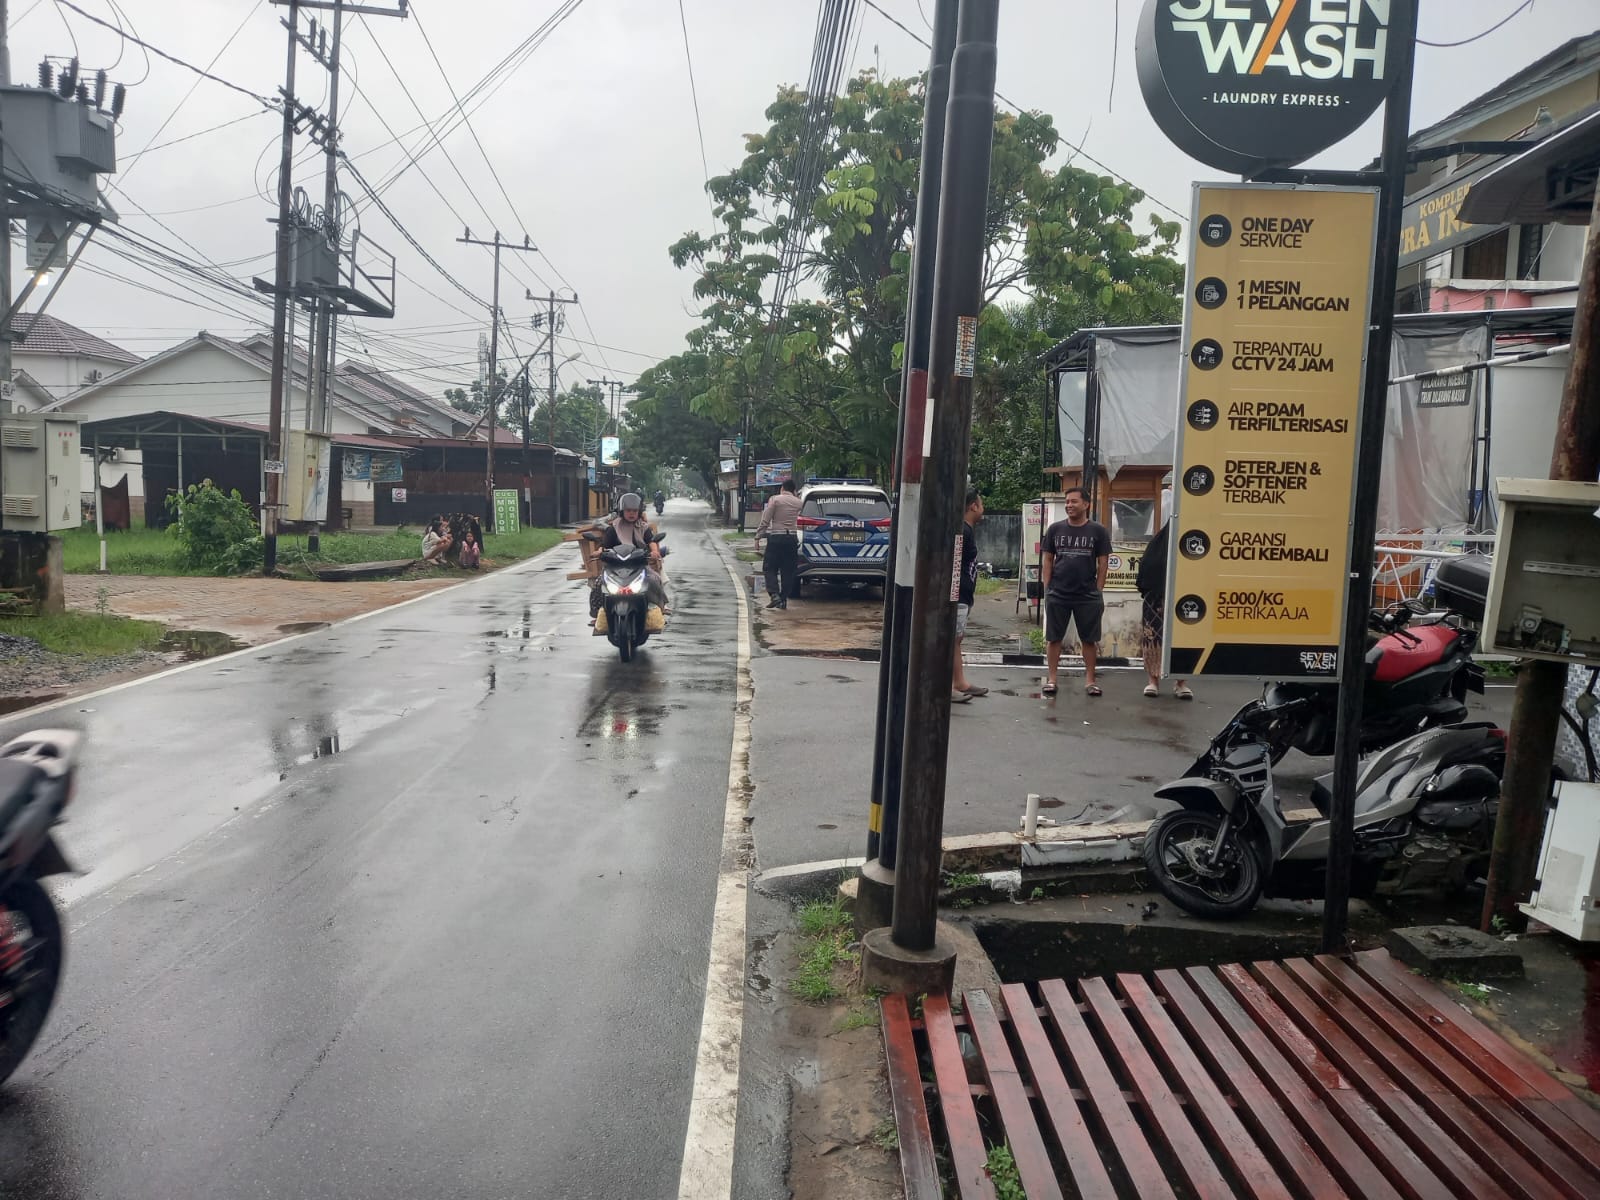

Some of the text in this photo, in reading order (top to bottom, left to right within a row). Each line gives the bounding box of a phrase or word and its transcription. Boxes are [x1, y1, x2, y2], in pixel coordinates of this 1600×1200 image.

[1172, 20, 1388, 80] WASH
[1213, 92, 1277, 105] LAUNDRY
[1282, 94, 1340, 107] EXPRESS
[1241, 217, 1314, 233] ONE DAY
[1240, 232, 1303, 248] SERVICE
[1237, 280, 1301, 295] 1 MESIN
[1236, 295, 1350, 311] 1 PELANGGAN
[1232, 341, 1323, 357] TERPANTAU
[1231, 356, 1334, 373] CCTV 24 JAM
[1228, 402, 1305, 417] AIR PDAM
[1227, 417, 1349, 433] TERFILTERISASI
[1225, 460, 1322, 476] DETERJEN &
[1223, 475, 1308, 490] SOFTENER
[1222, 489, 1286, 504] TERBAIK
[1220, 532, 1286, 546] GARANSI
[1219, 547, 1329, 562] CUCI KEMBALI
[1217, 590, 1284, 607] 5.000/KG
[1216, 606, 1310, 621] SETRIKA AJA
[1300, 651, 1337, 661] SEVEN
[1300, 660, 1336, 670] WASH
